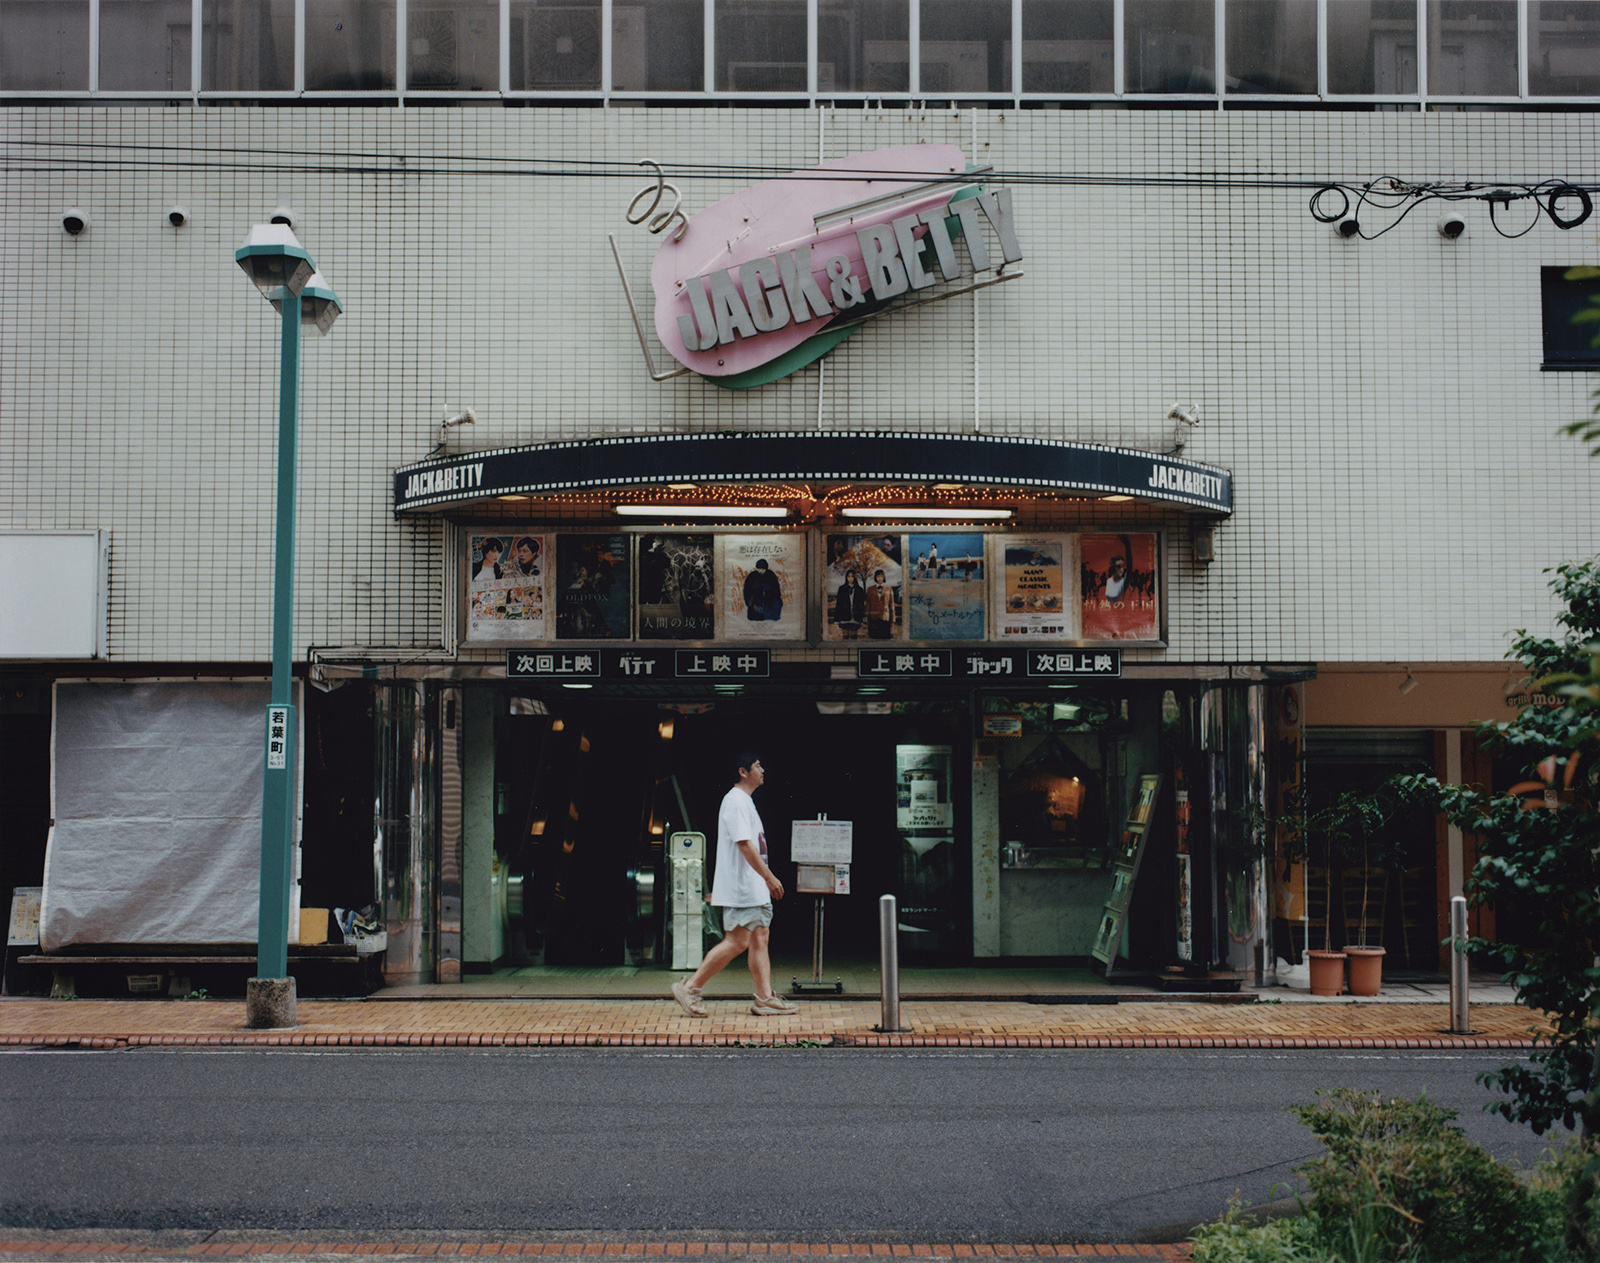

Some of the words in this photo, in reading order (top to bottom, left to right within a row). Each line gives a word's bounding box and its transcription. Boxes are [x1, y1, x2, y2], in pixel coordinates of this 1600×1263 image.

[405, 463, 484, 499] JACK&BETTY
[1148, 464, 1222, 501] JACK&BETTY
[738, 545, 787, 554] 悪は存在しない
[643, 616, 710, 629] 人間の境界
[515, 654, 593, 673] 次回上映
[619, 656, 656, 675] ベティ
[687, 654, 758, 673] 上映中
[870, 653, 941, 672] 上映中
[966, 656, 1014, 675] ジャック
[1036, 653, 1113, 672] 次回上映
[271, 711, 285, 754] 若葉町
